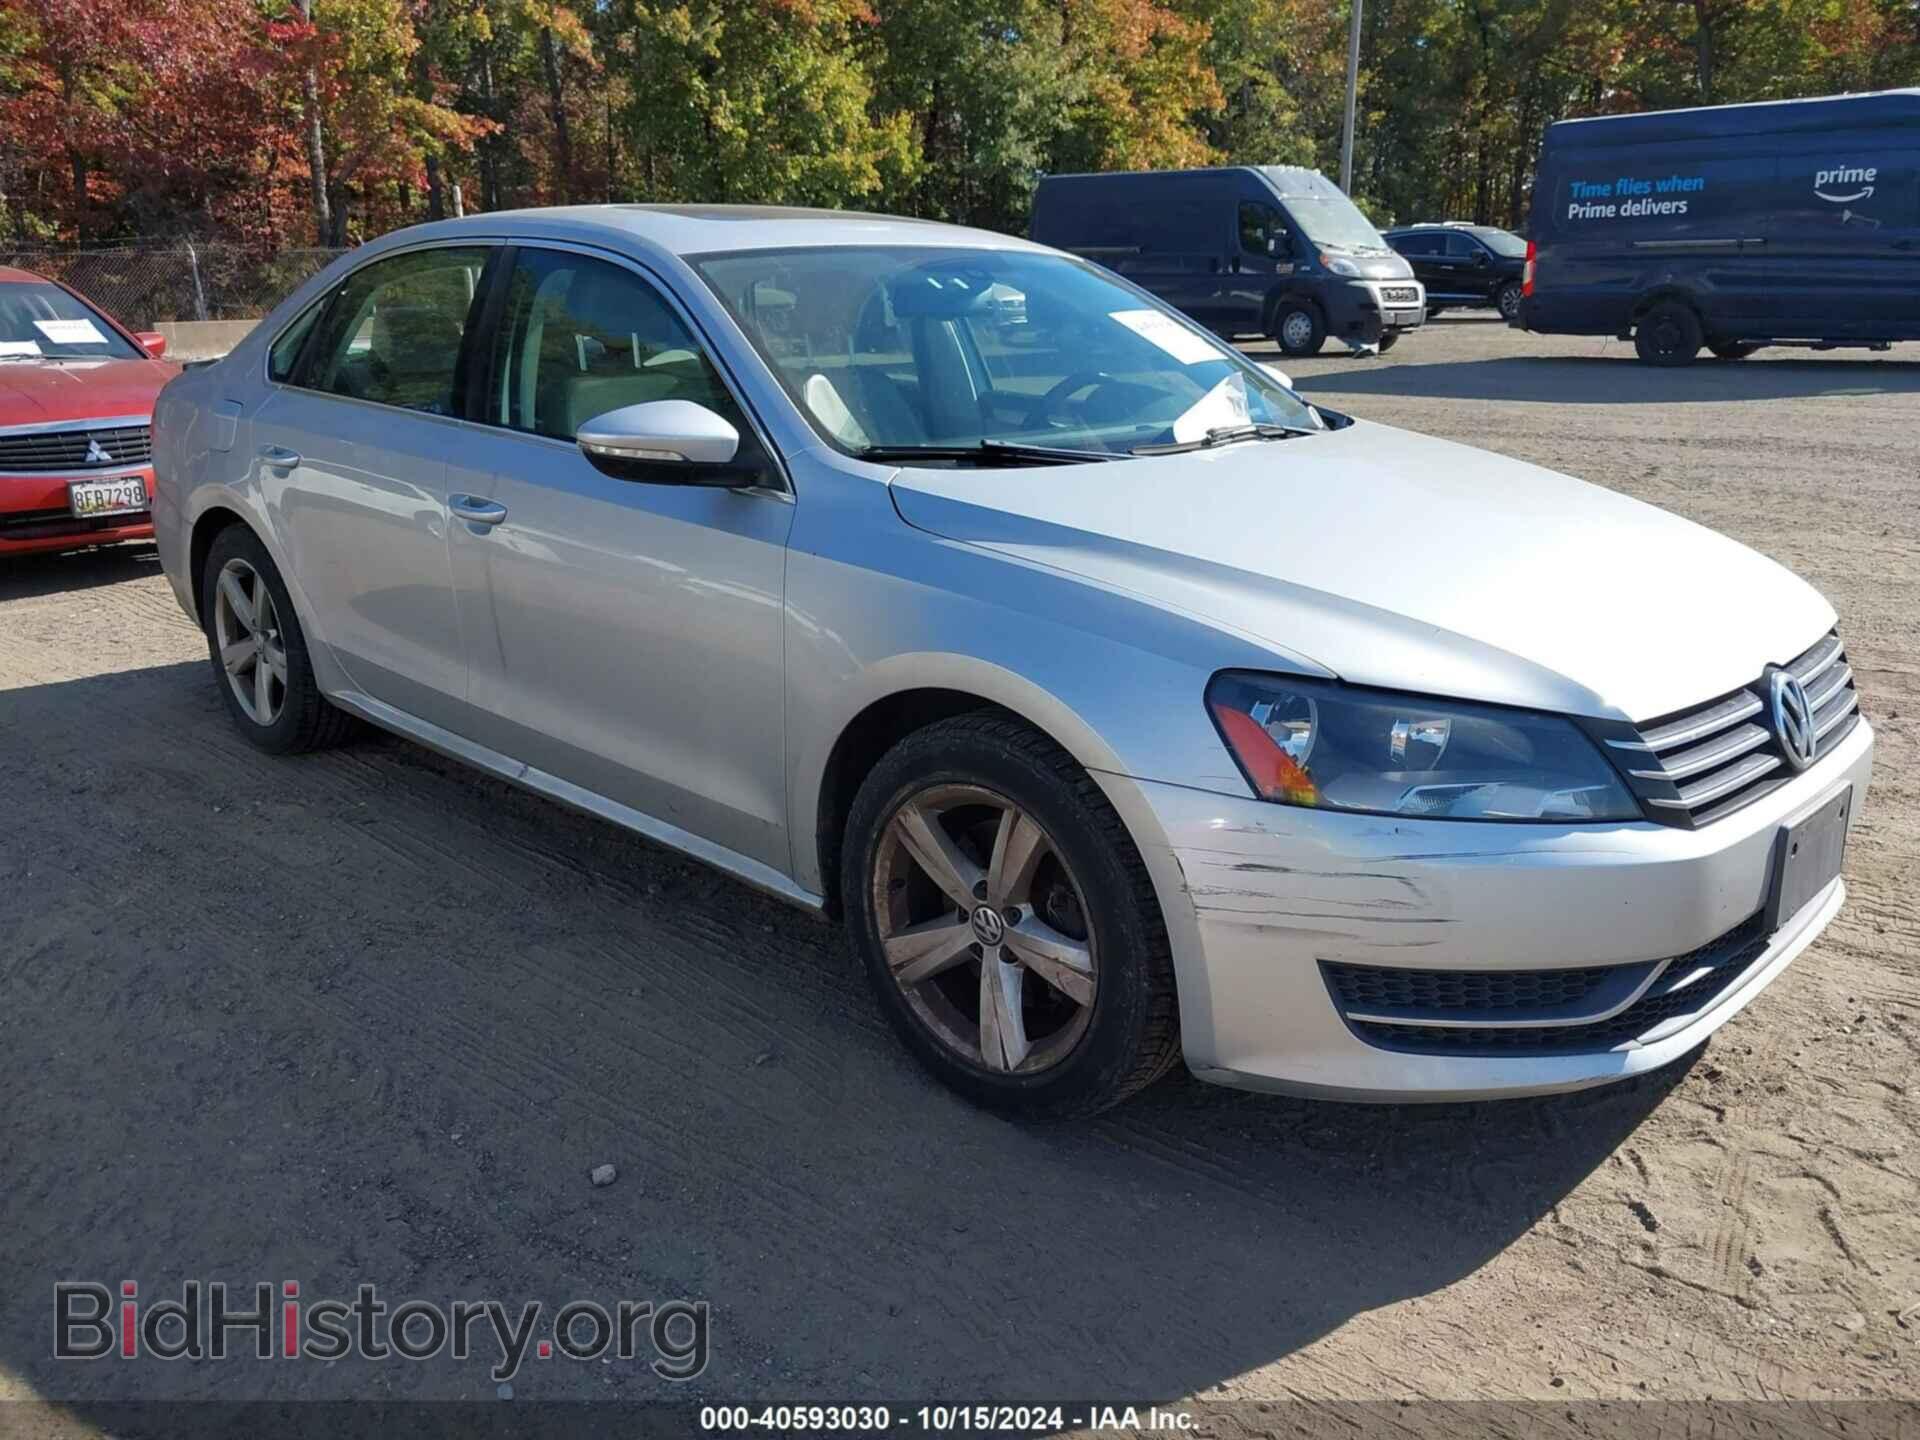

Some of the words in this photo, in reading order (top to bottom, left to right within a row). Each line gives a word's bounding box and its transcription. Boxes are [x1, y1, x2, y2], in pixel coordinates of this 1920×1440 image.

[1569, 181, 1611, 199] Time
[1615, 177, 1651, 195] flies
[1656, 174, 1704, 193] when
[1814, 165, 1877, 188] prime
[1568, 202, 1616, 219] Prime
[1620, 198, 1688, 216] delivers
